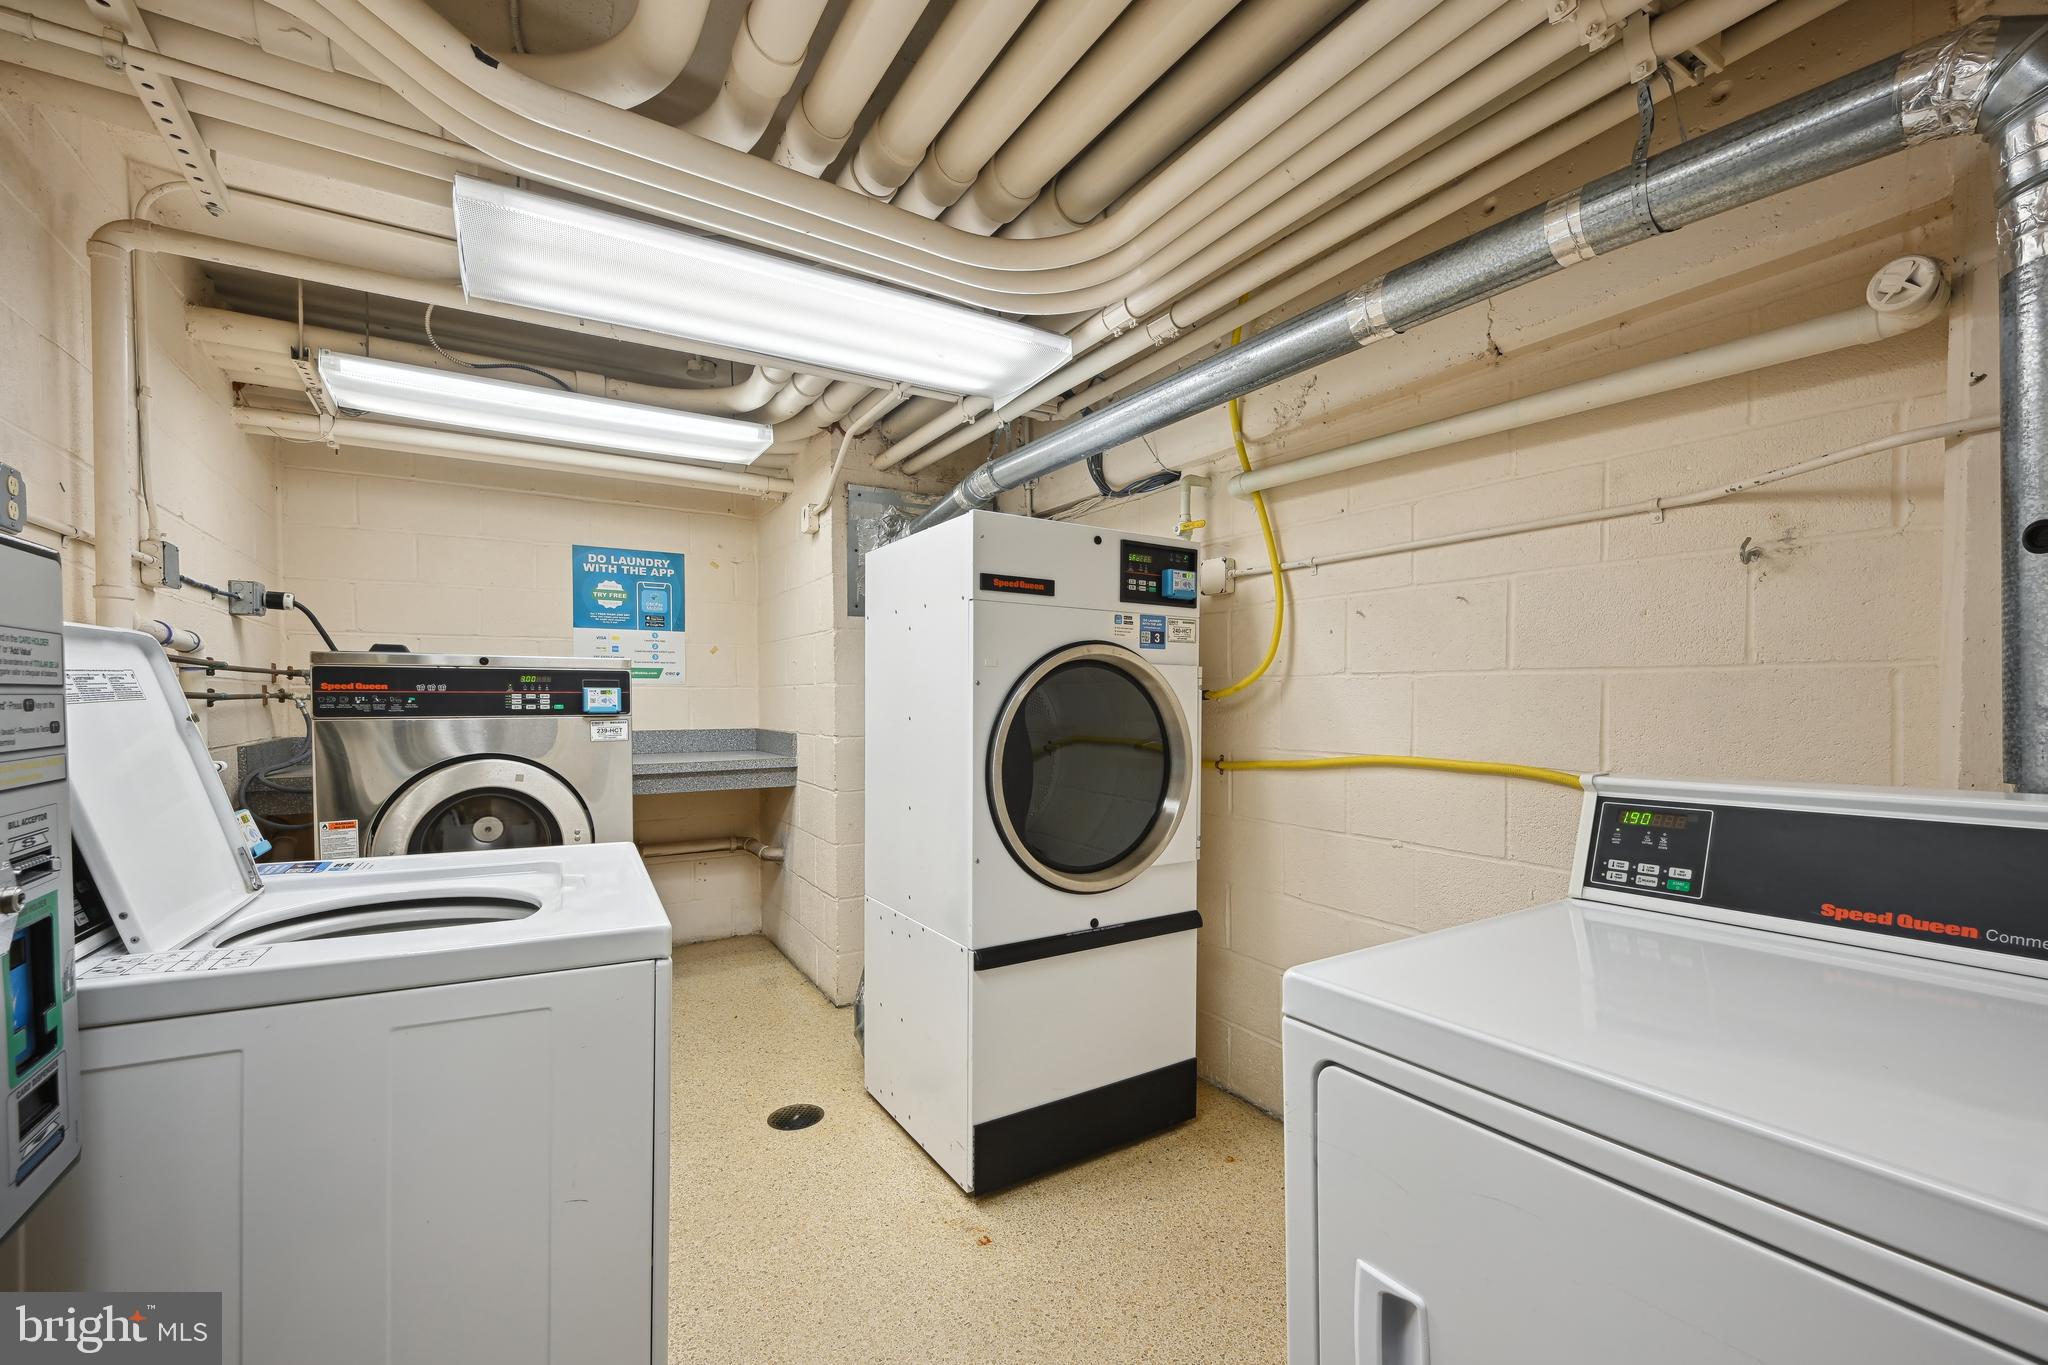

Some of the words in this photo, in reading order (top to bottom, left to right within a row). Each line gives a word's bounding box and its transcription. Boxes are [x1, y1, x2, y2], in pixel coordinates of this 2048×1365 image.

[588, 553, 606, 563] DO
[611, 555, 671, 568] LAUNDRY
[583, 563, 617, 574] WITH
[621, 565, 647, 576] THE
[650, 568, 675, 577] APP
[993, 577, 1019, 588] Speed
[1020, 580, 1045, 590] Queen
[1154, 633, 1160, 643] 3
[320, 682, 354, 690] Speed
[355, 682, 389, 690] Queen
[8, 820, 20, 830] BILL
[21, 812, 48, 826] ACCEPTOR
[1820, 903, 1892, 927] Speed
[1897, 913, 1979, 939] Queen
[16, 1082, 32, 1099] CARD
